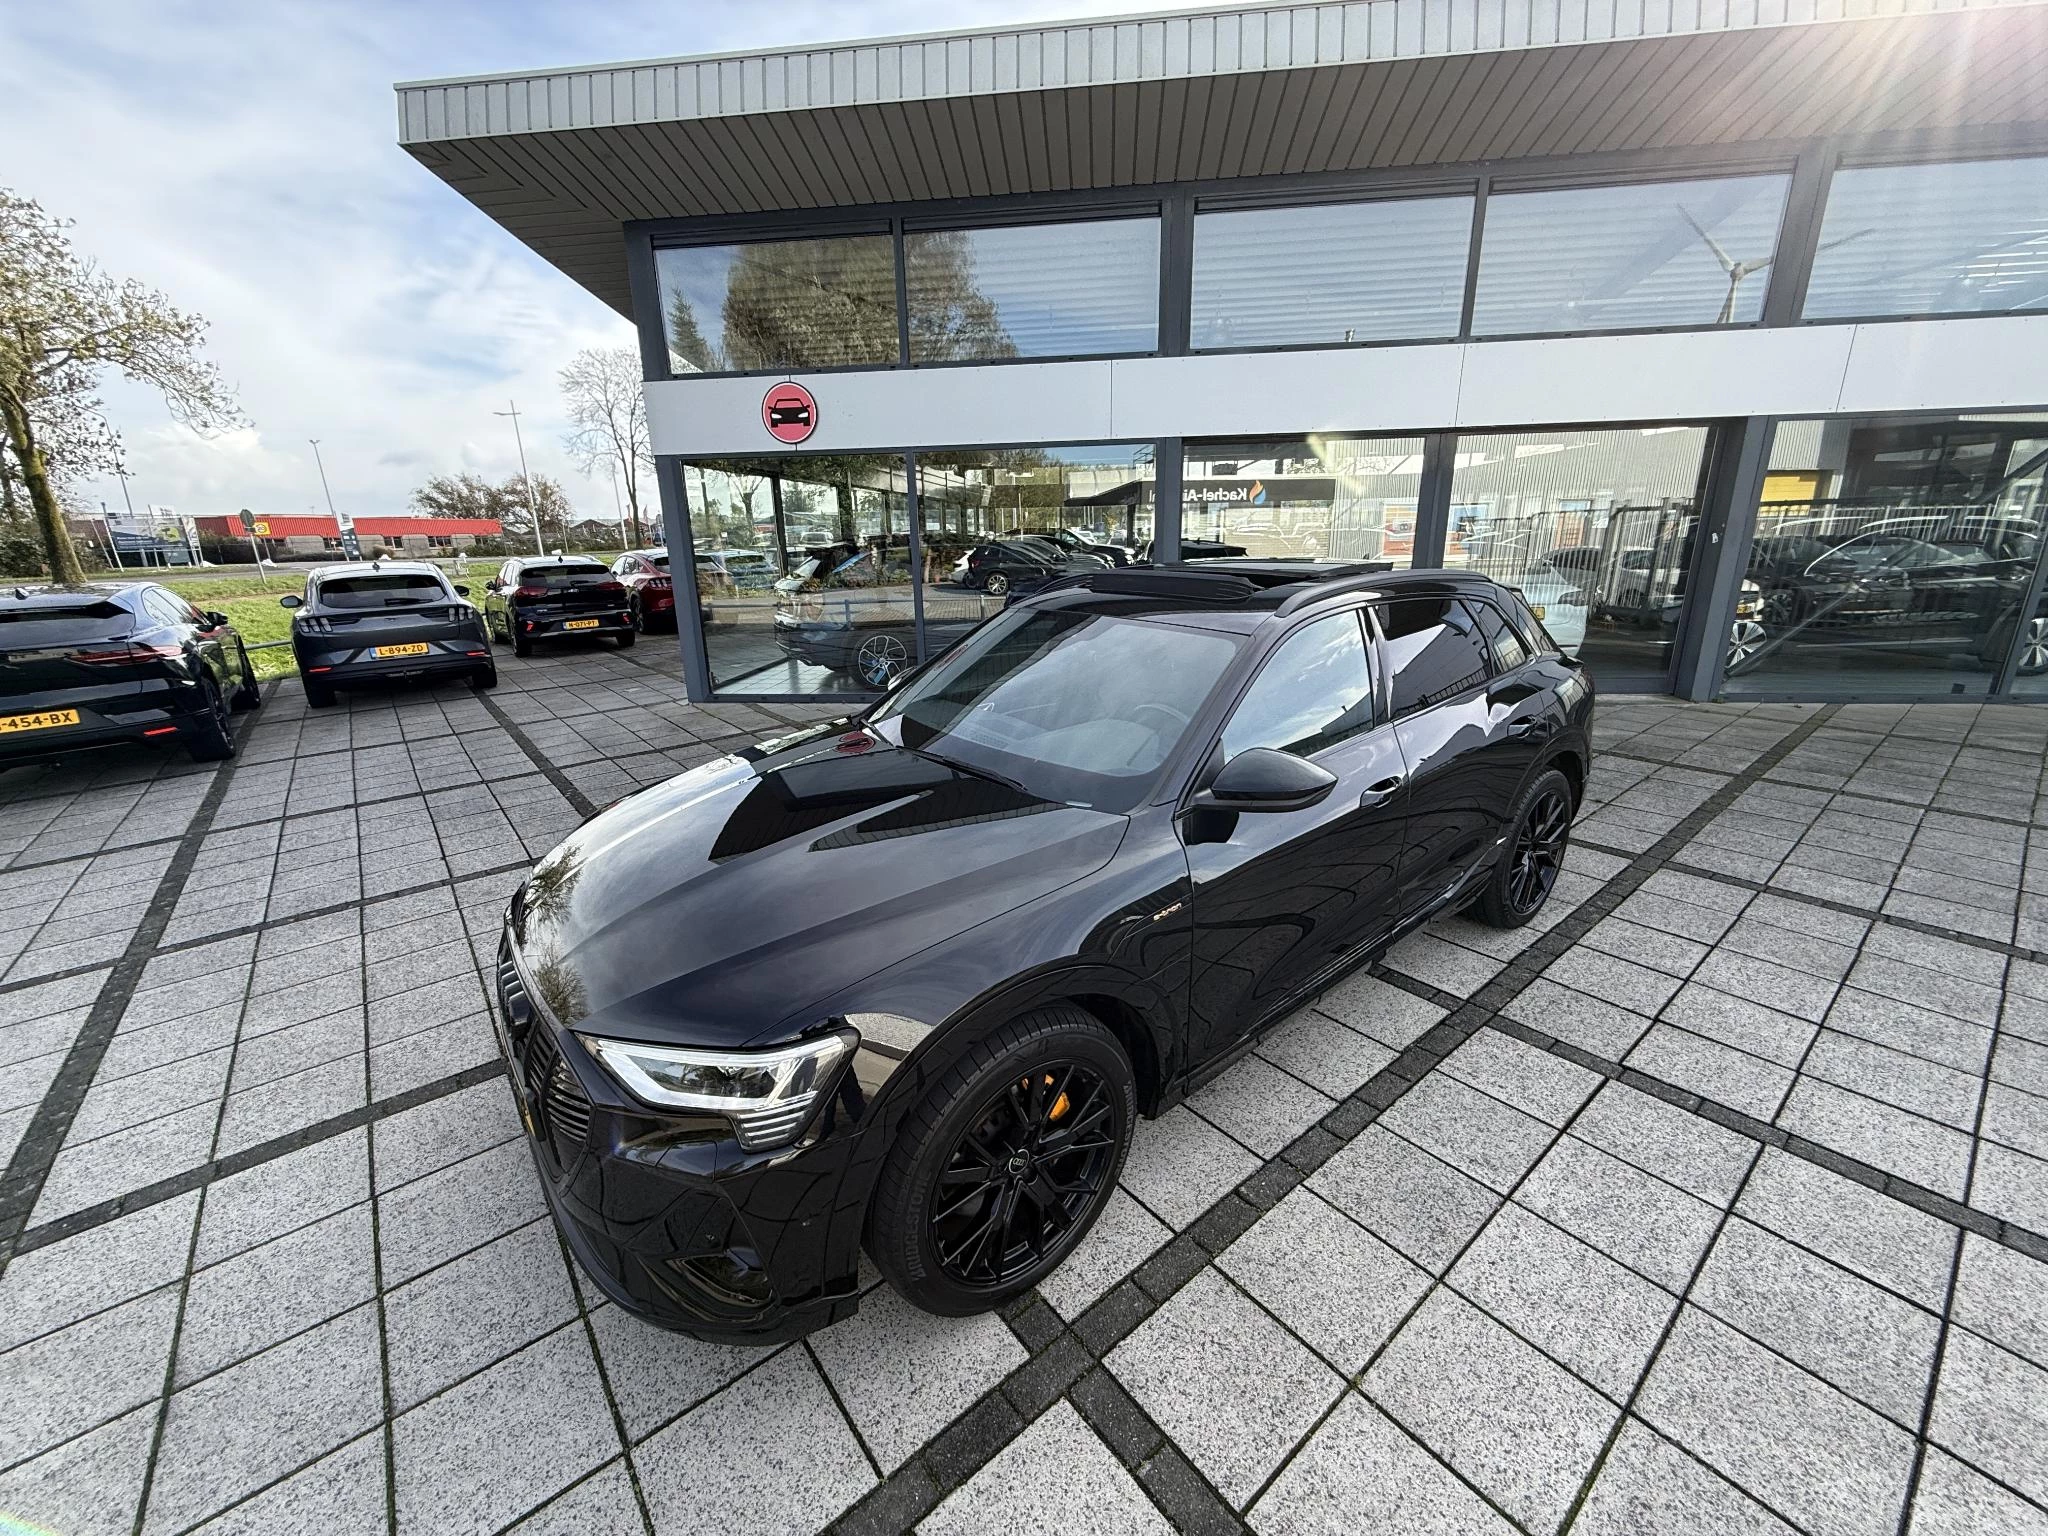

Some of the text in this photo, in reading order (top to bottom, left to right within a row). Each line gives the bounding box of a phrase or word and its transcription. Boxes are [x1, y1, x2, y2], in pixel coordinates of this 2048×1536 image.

[379, 644, 424, 656] L-894-ZD
[0, 711, 73, 731] -454-BX
[903, 1168, 932, 1282] BRIDGESTONE
